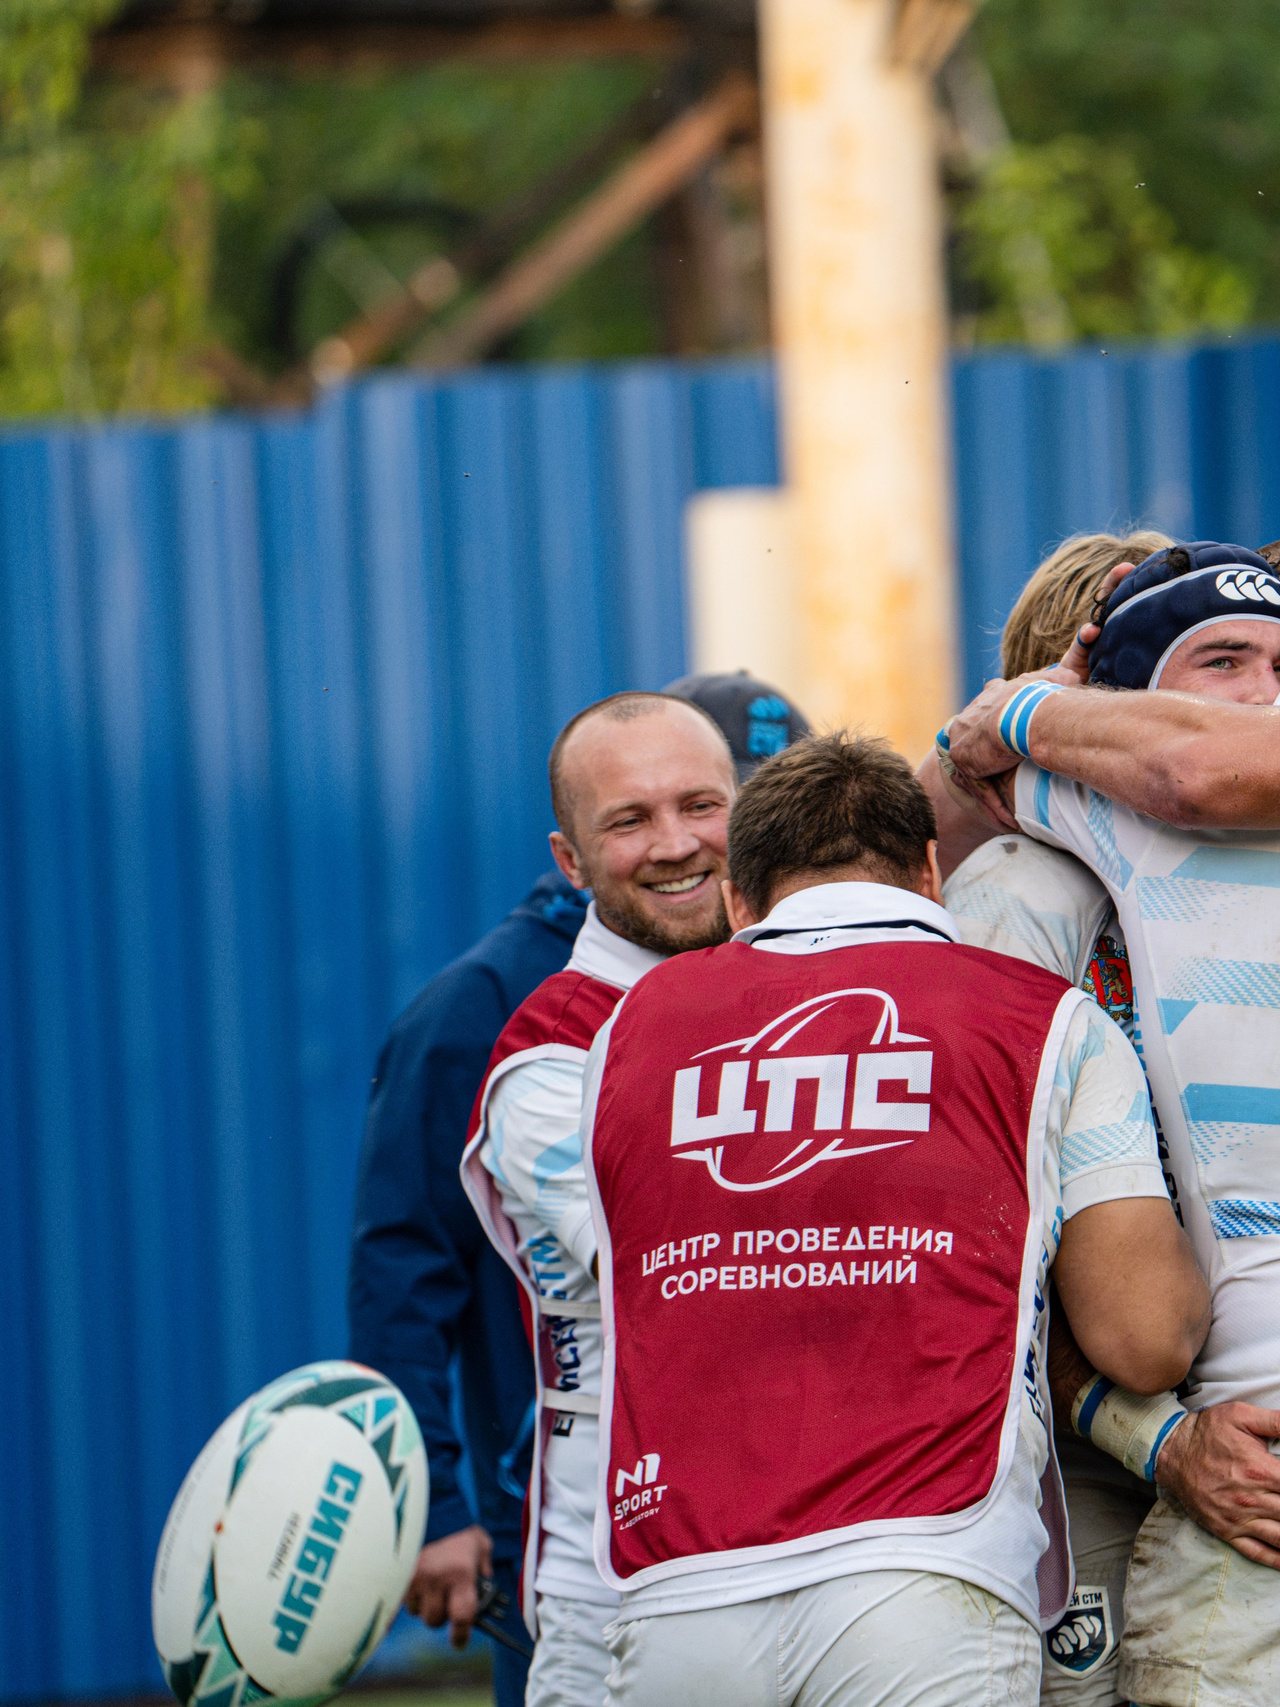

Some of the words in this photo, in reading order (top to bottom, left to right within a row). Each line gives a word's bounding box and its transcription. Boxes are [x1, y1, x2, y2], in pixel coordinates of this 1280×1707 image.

[670, 1051, 933, 1147] ЦПС
[642, 1232, 721, 1276] ЦЕНТР
[733, 1225, 953, 1255] ПРОВЕДЕНИЯ
[661, 1254, 918, 1300] СОРЕВНОВАНИЙ
[614, 1485, 668, 1521] SPORT
[271, 1460, 364, 1657] СИБУР
[1082, 1592, 1103, 1605] СТМ
